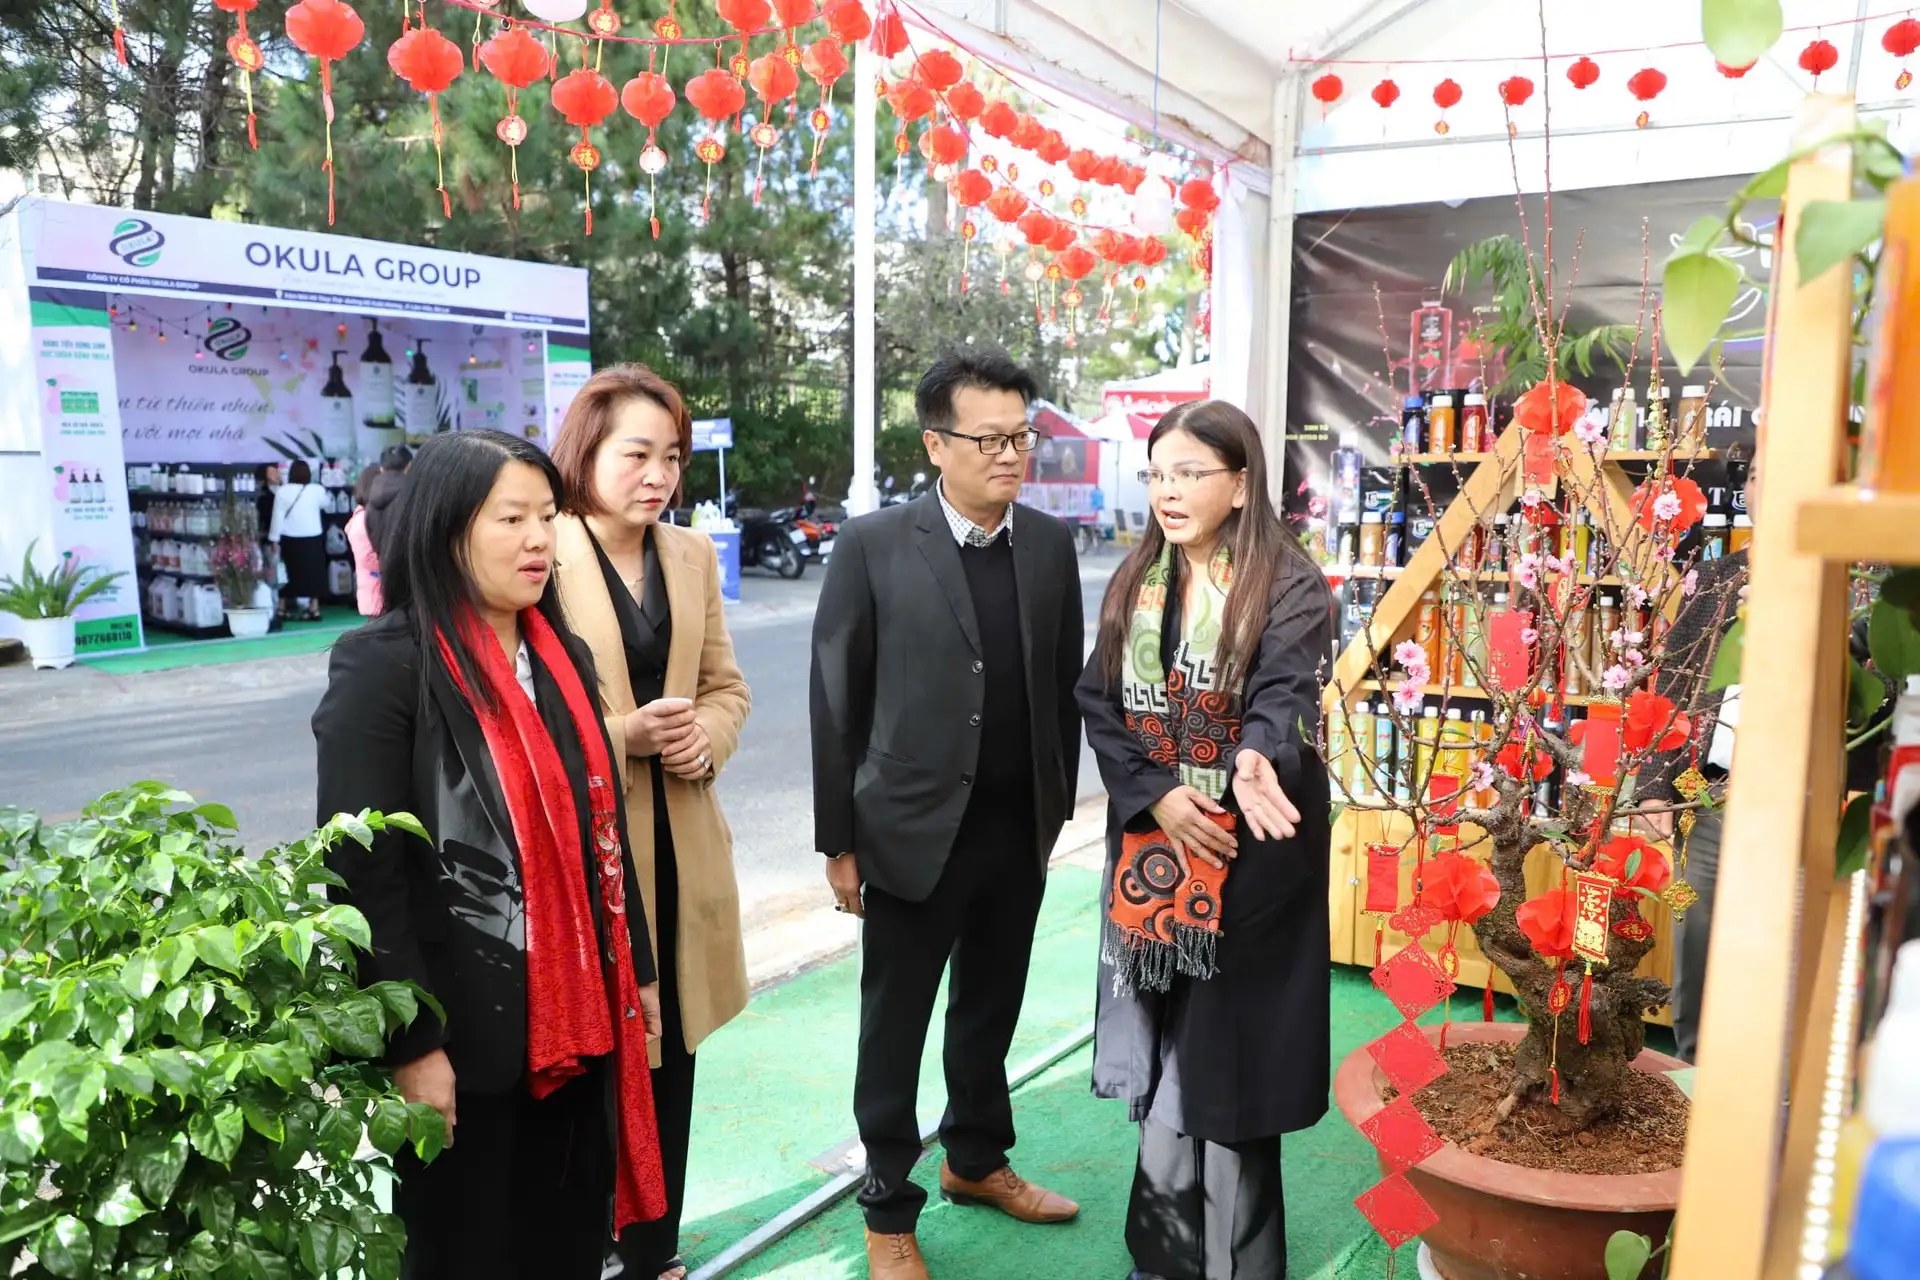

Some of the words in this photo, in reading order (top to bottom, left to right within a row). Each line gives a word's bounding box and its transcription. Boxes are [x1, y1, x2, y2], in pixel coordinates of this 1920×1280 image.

[245, 241, 364, 277] OKULA
[375, 257, 481, 288] GROUP
[109, 275, 119, 283] TY
[188, 364, 229, 376] OKULA
[231, 366, 269, 377] GROUP
